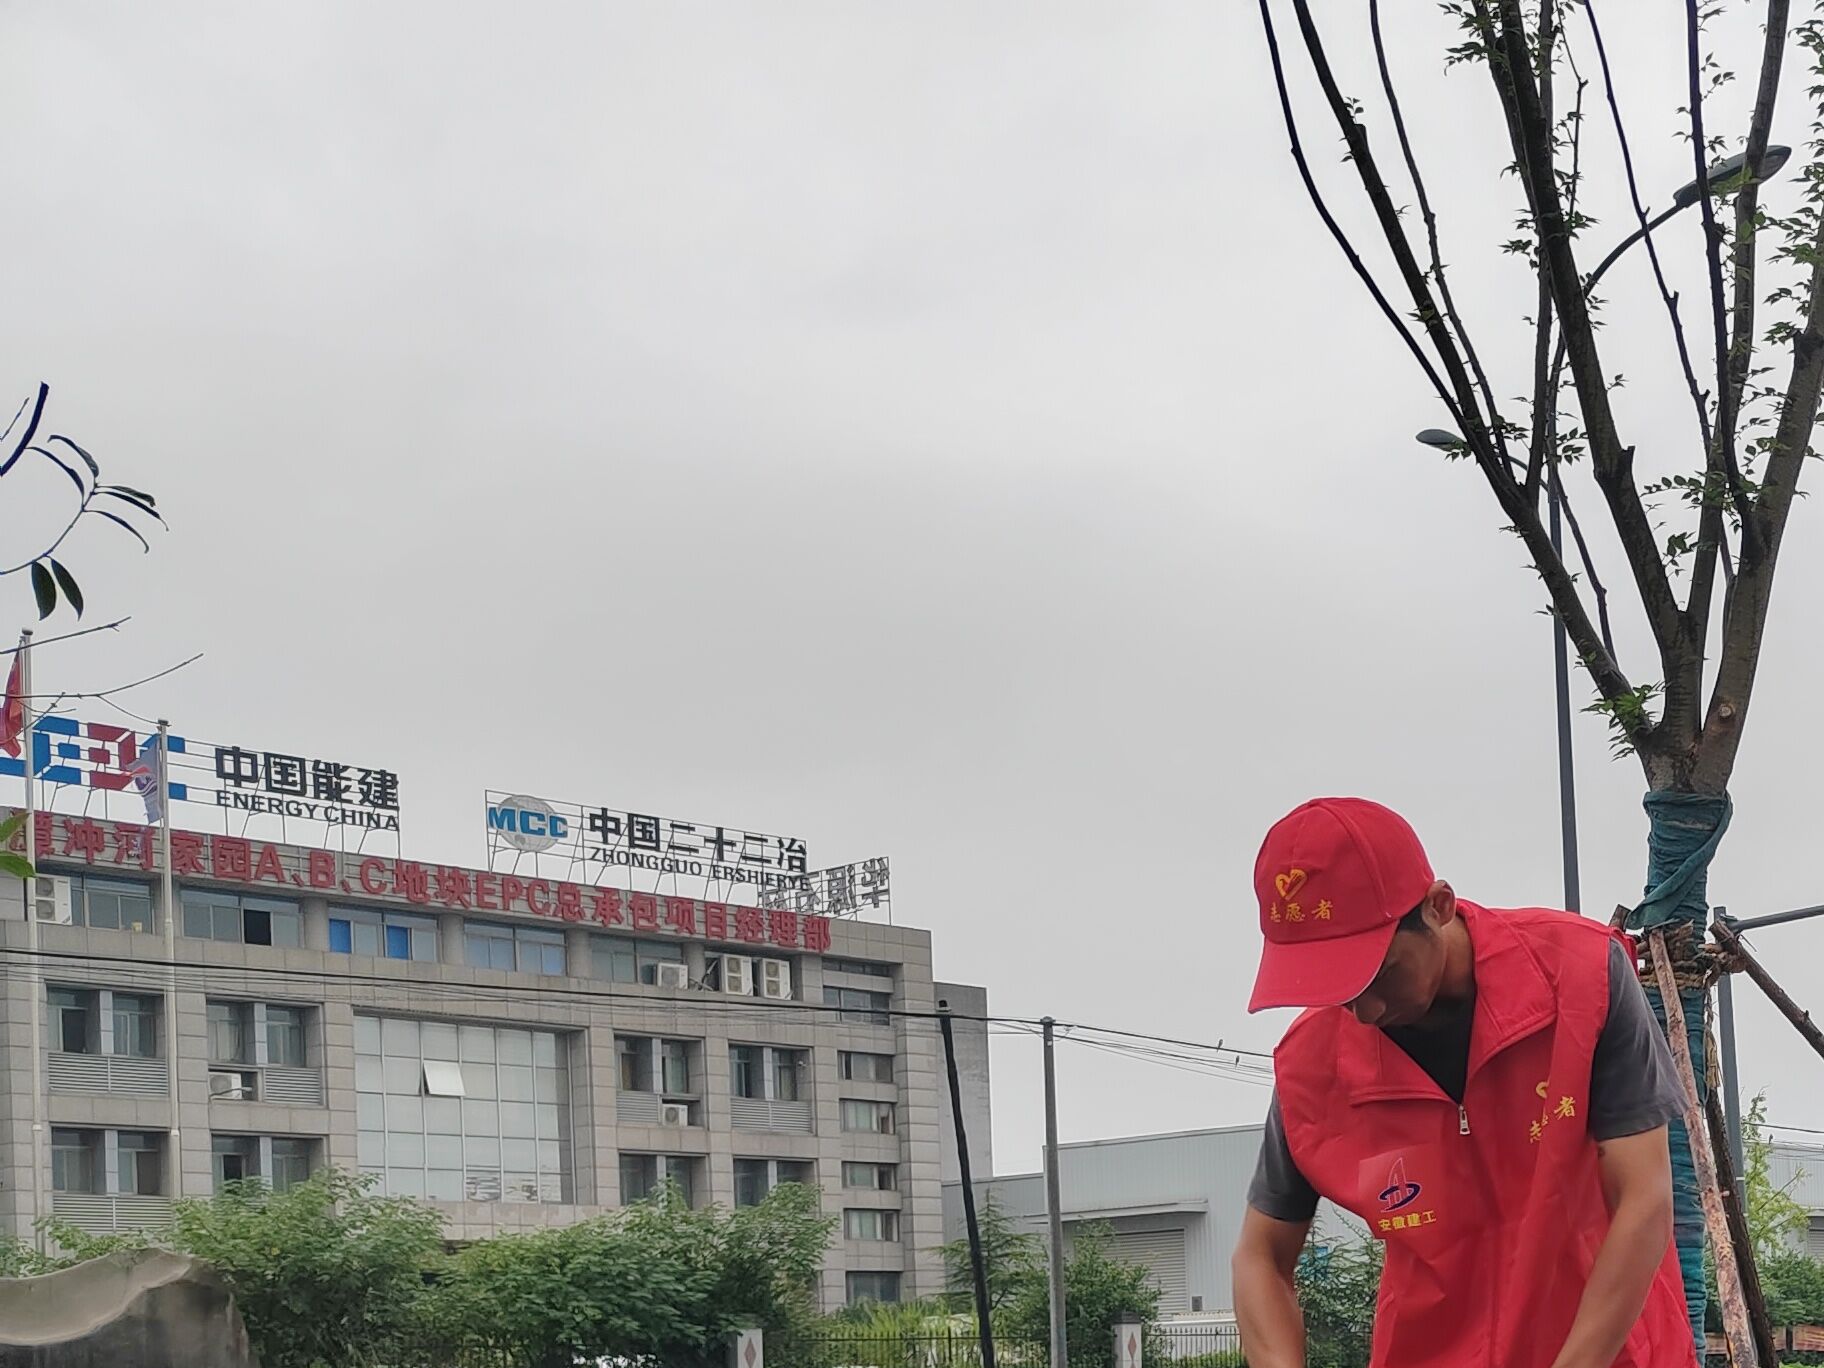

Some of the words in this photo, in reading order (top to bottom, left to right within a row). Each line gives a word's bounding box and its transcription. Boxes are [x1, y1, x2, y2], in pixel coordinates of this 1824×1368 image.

[215, 746, 400, 811] 中国能建
[216, 789, 319, 820] ENERGY
[324, 805, 400, 832] CHINA
[488, 806, 568, 839] MCC
[589, 807, 807, 874] 中国二十二冶
[589, 846, 702, 876] ZHONGGUO
[712, 864, 810, 892] ERSHIERYE
[1270, 899, 1334, 923] 志愿者
[1529, 1095, 1576, 1144] 志者
[1378, 1210, 1437, 1232] 安徽建工
